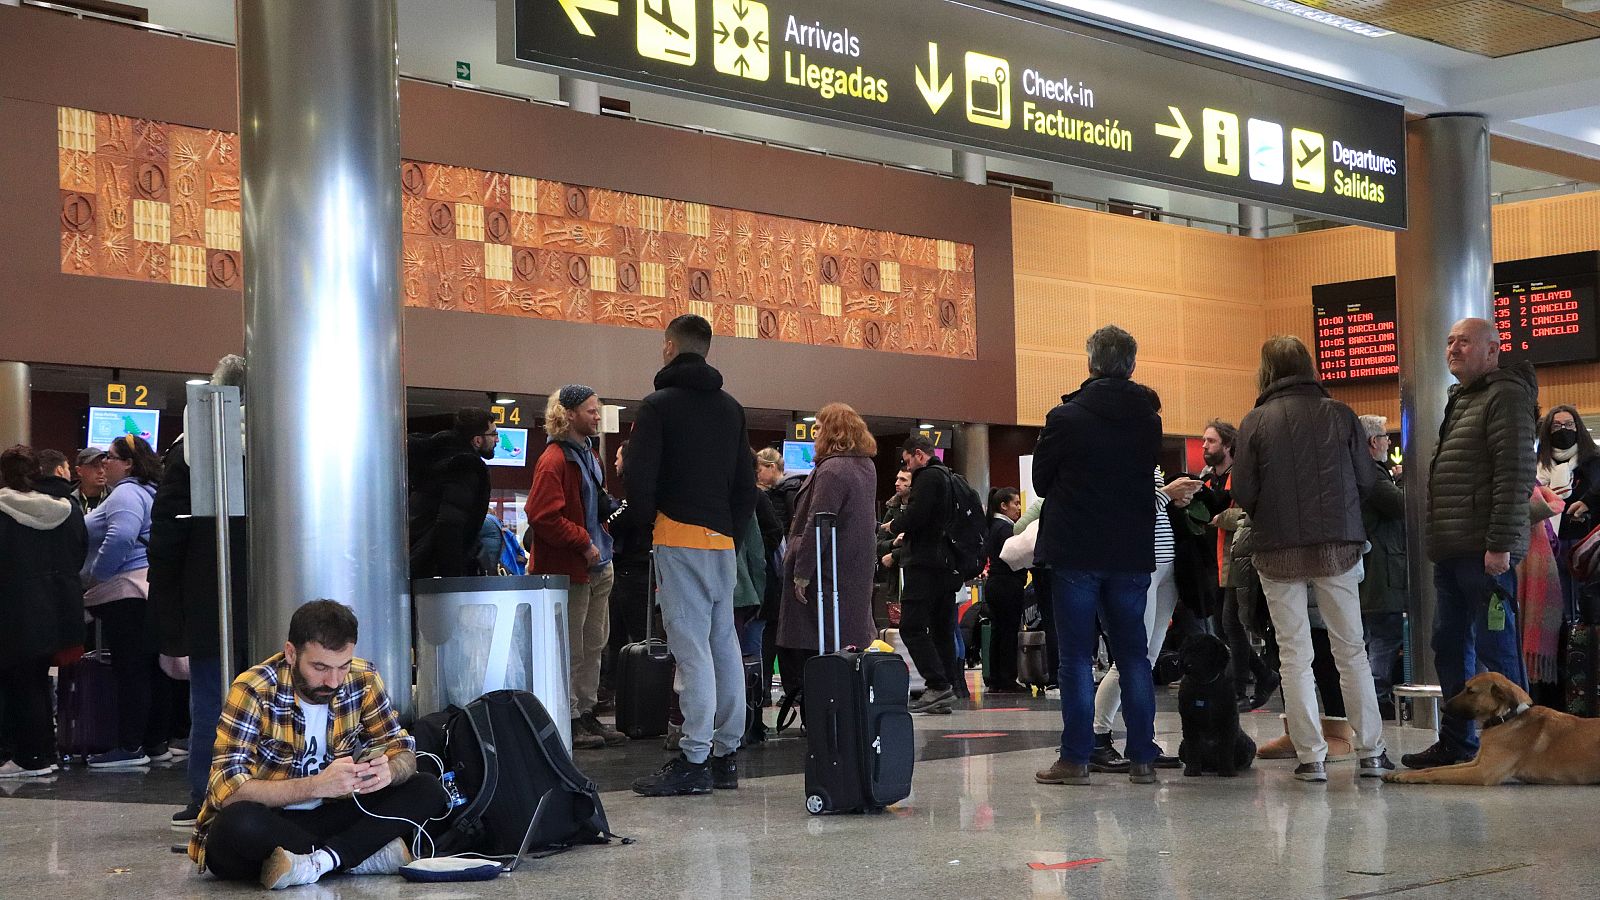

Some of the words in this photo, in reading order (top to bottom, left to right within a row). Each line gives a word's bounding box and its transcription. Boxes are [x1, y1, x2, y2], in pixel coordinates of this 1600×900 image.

[784, 14, 860, 58] Arrivals
[784, 50, 888, 103] Llegadas
[1022, 68, 1094, 108] Check-in
[1023, 101, 1132, 152] Facturación
[1332, 140, 1397, 176] Departures
[1333, 169, 1385, 204] Salidas
[1493, 297, 1510, 306] :30
[1519, 295, 1526, 304] 5
[1530, 290, 1572, 302] DELAYED
[1494, 309, 1511, 317] :35
[1520, 306, 1527, 315] 2
[1531, 301, 1578, 314] CANCELED
[1318, 316, 1344, 326] 10:00
[1347, 312, 1374, 323] VIENA
[1494, 320, 1511, 329] :35
[1521, 318, 1527, 327] 2
[1532, 312, 1579, 326] CANCELED
[1319, 327, 1344, 337] 10:05
[1347, 321, 1394, 334] BARCELONA
[1499, 331, 1512, 340] 35
[1532, 324, 1579, 337] CANCELED
[1320, 337, 1345, 348] 10:05
[1348, 332, 1395, 345] BARCELONA
[1500, 342, 1512, 352] 45
[1521, 341, 1528, 350] 6
[1320, 348, 1346, 359] 10:05
[1349, 343, 1396, 356] BARCELONA
[1321, 359, 1346, 370] 10:15
[1349, 354, 1396, 367] EDIMBURGO
[1321, 370, 1347, 380] 14:10
[134, 385, 148, 406] 2
[509, 407, 521, 425] 4
[934, 431, 942, 447] 7
[303, 735, 318, 759] A
